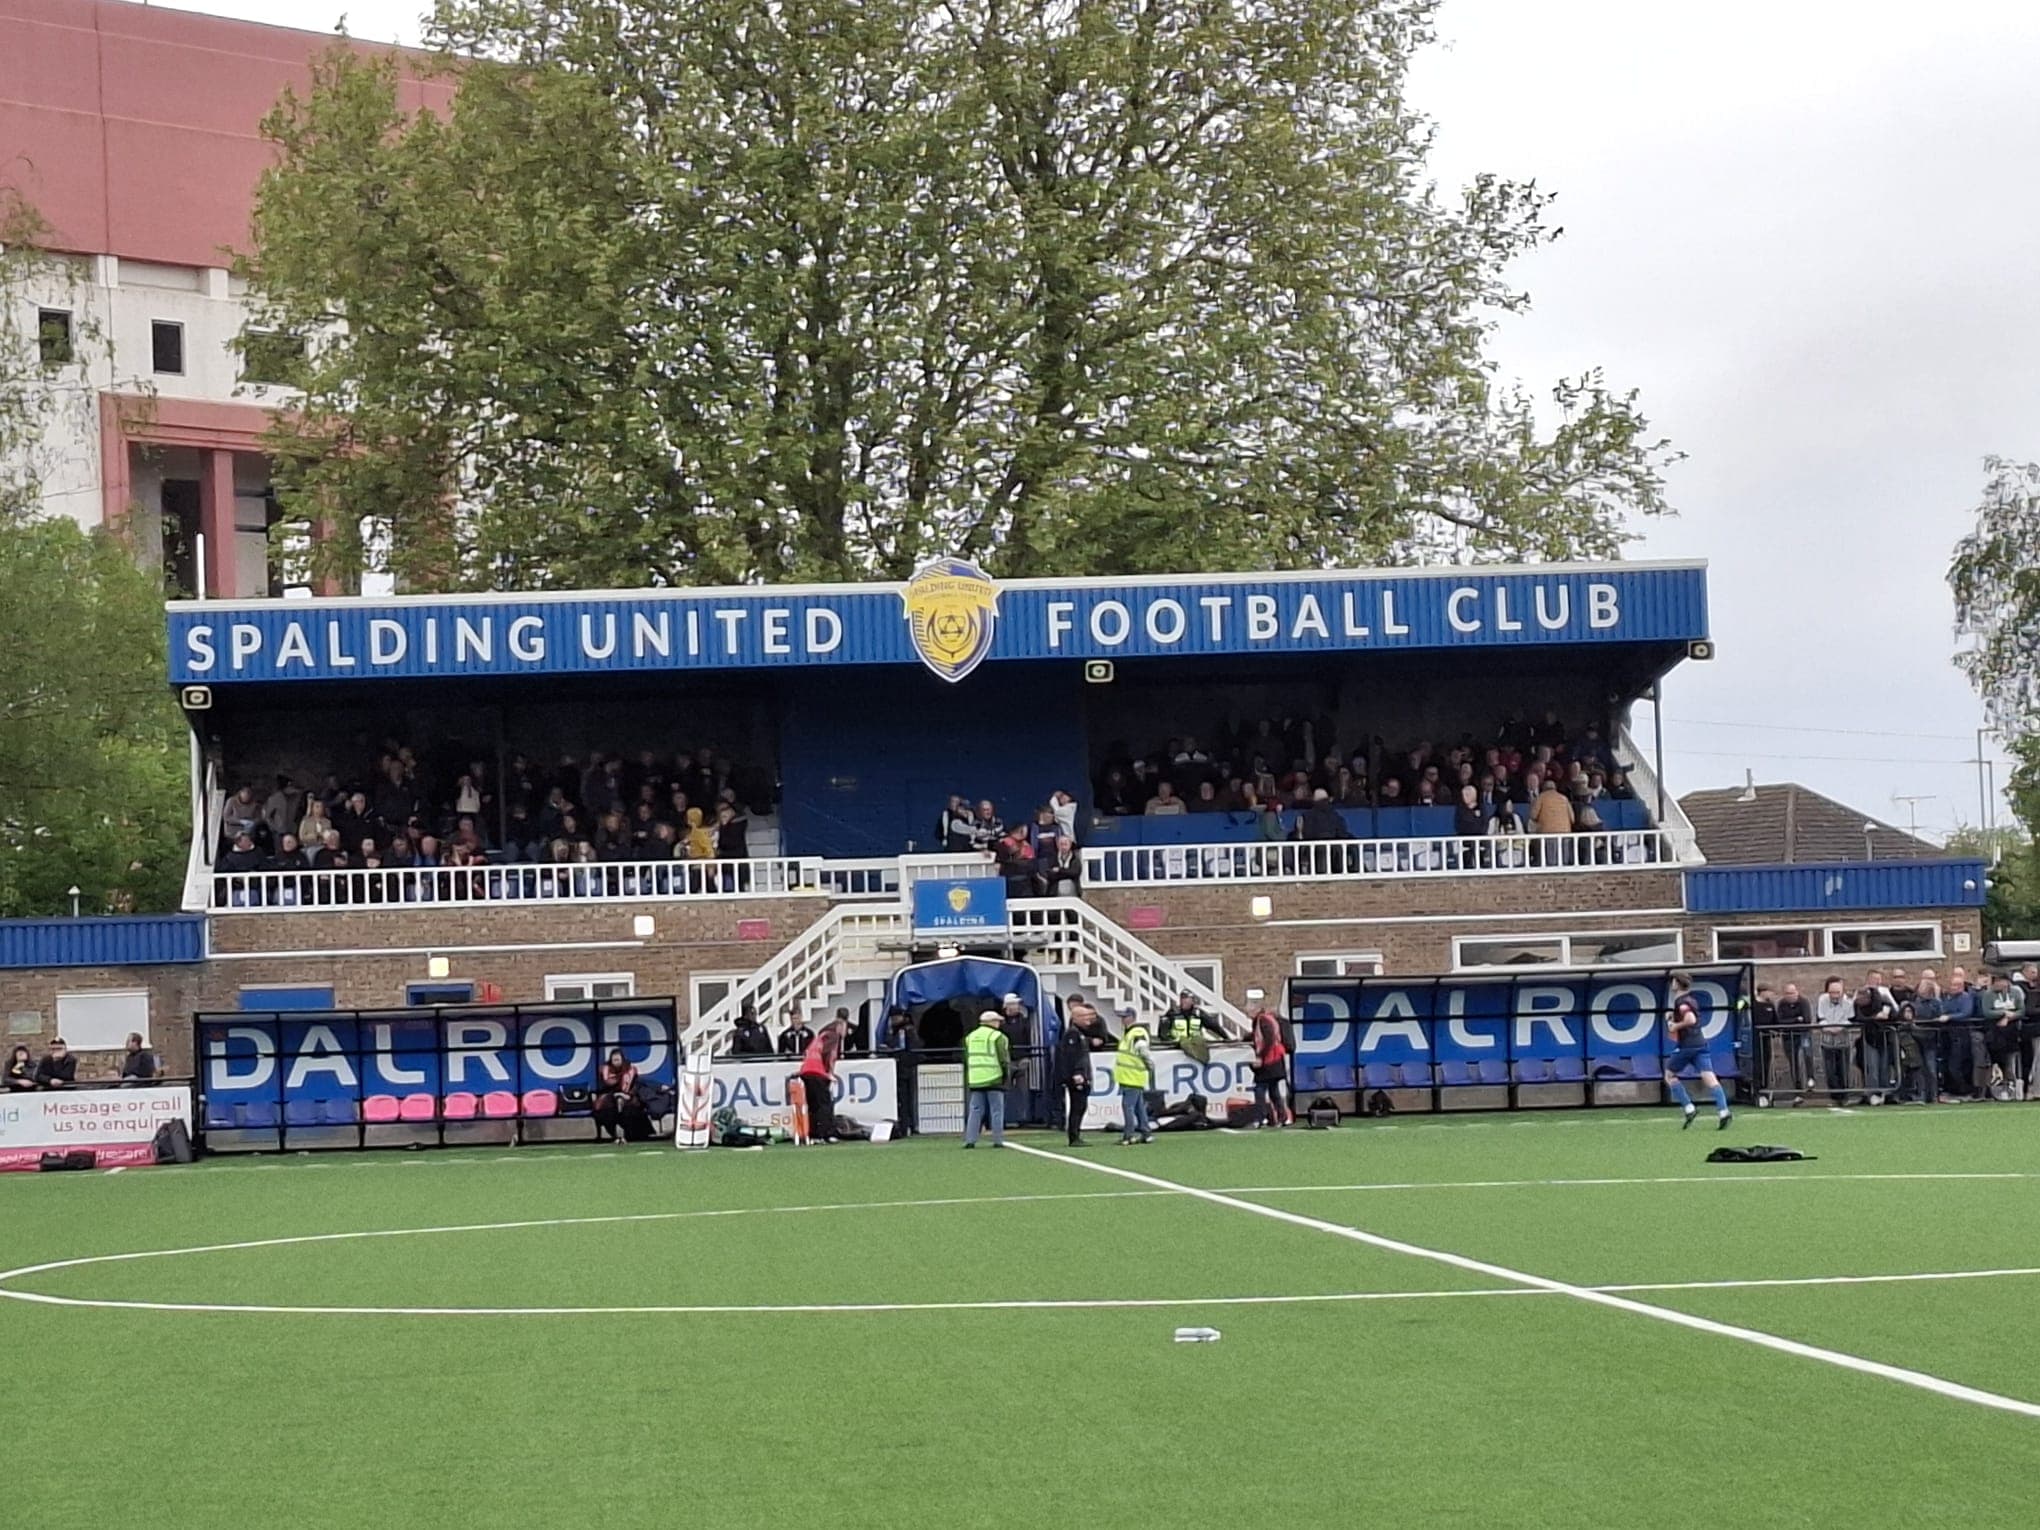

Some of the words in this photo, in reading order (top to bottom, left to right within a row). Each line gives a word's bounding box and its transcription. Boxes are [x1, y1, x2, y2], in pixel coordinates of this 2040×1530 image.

[186, 615, 546, 671] SPALDING
[580, 607, 843, 660] UNITED
[1047, 590, 1409, 647] FOOTBALL
[1447, 584, 1621, 632] CLUB
[1292, 979, 1729, 1054] DALROD
[209, 1015, 668, 1090] DALROD
[43, 1102, 122, 1116] Message
[127, 1101, 144, 1111] or
[151, 1096, 181, 1111] call
[711, 1072, 878, 1108] DALD
[53, 1123, 74, 1132] us
[80, 1120, 97, 1131] to
